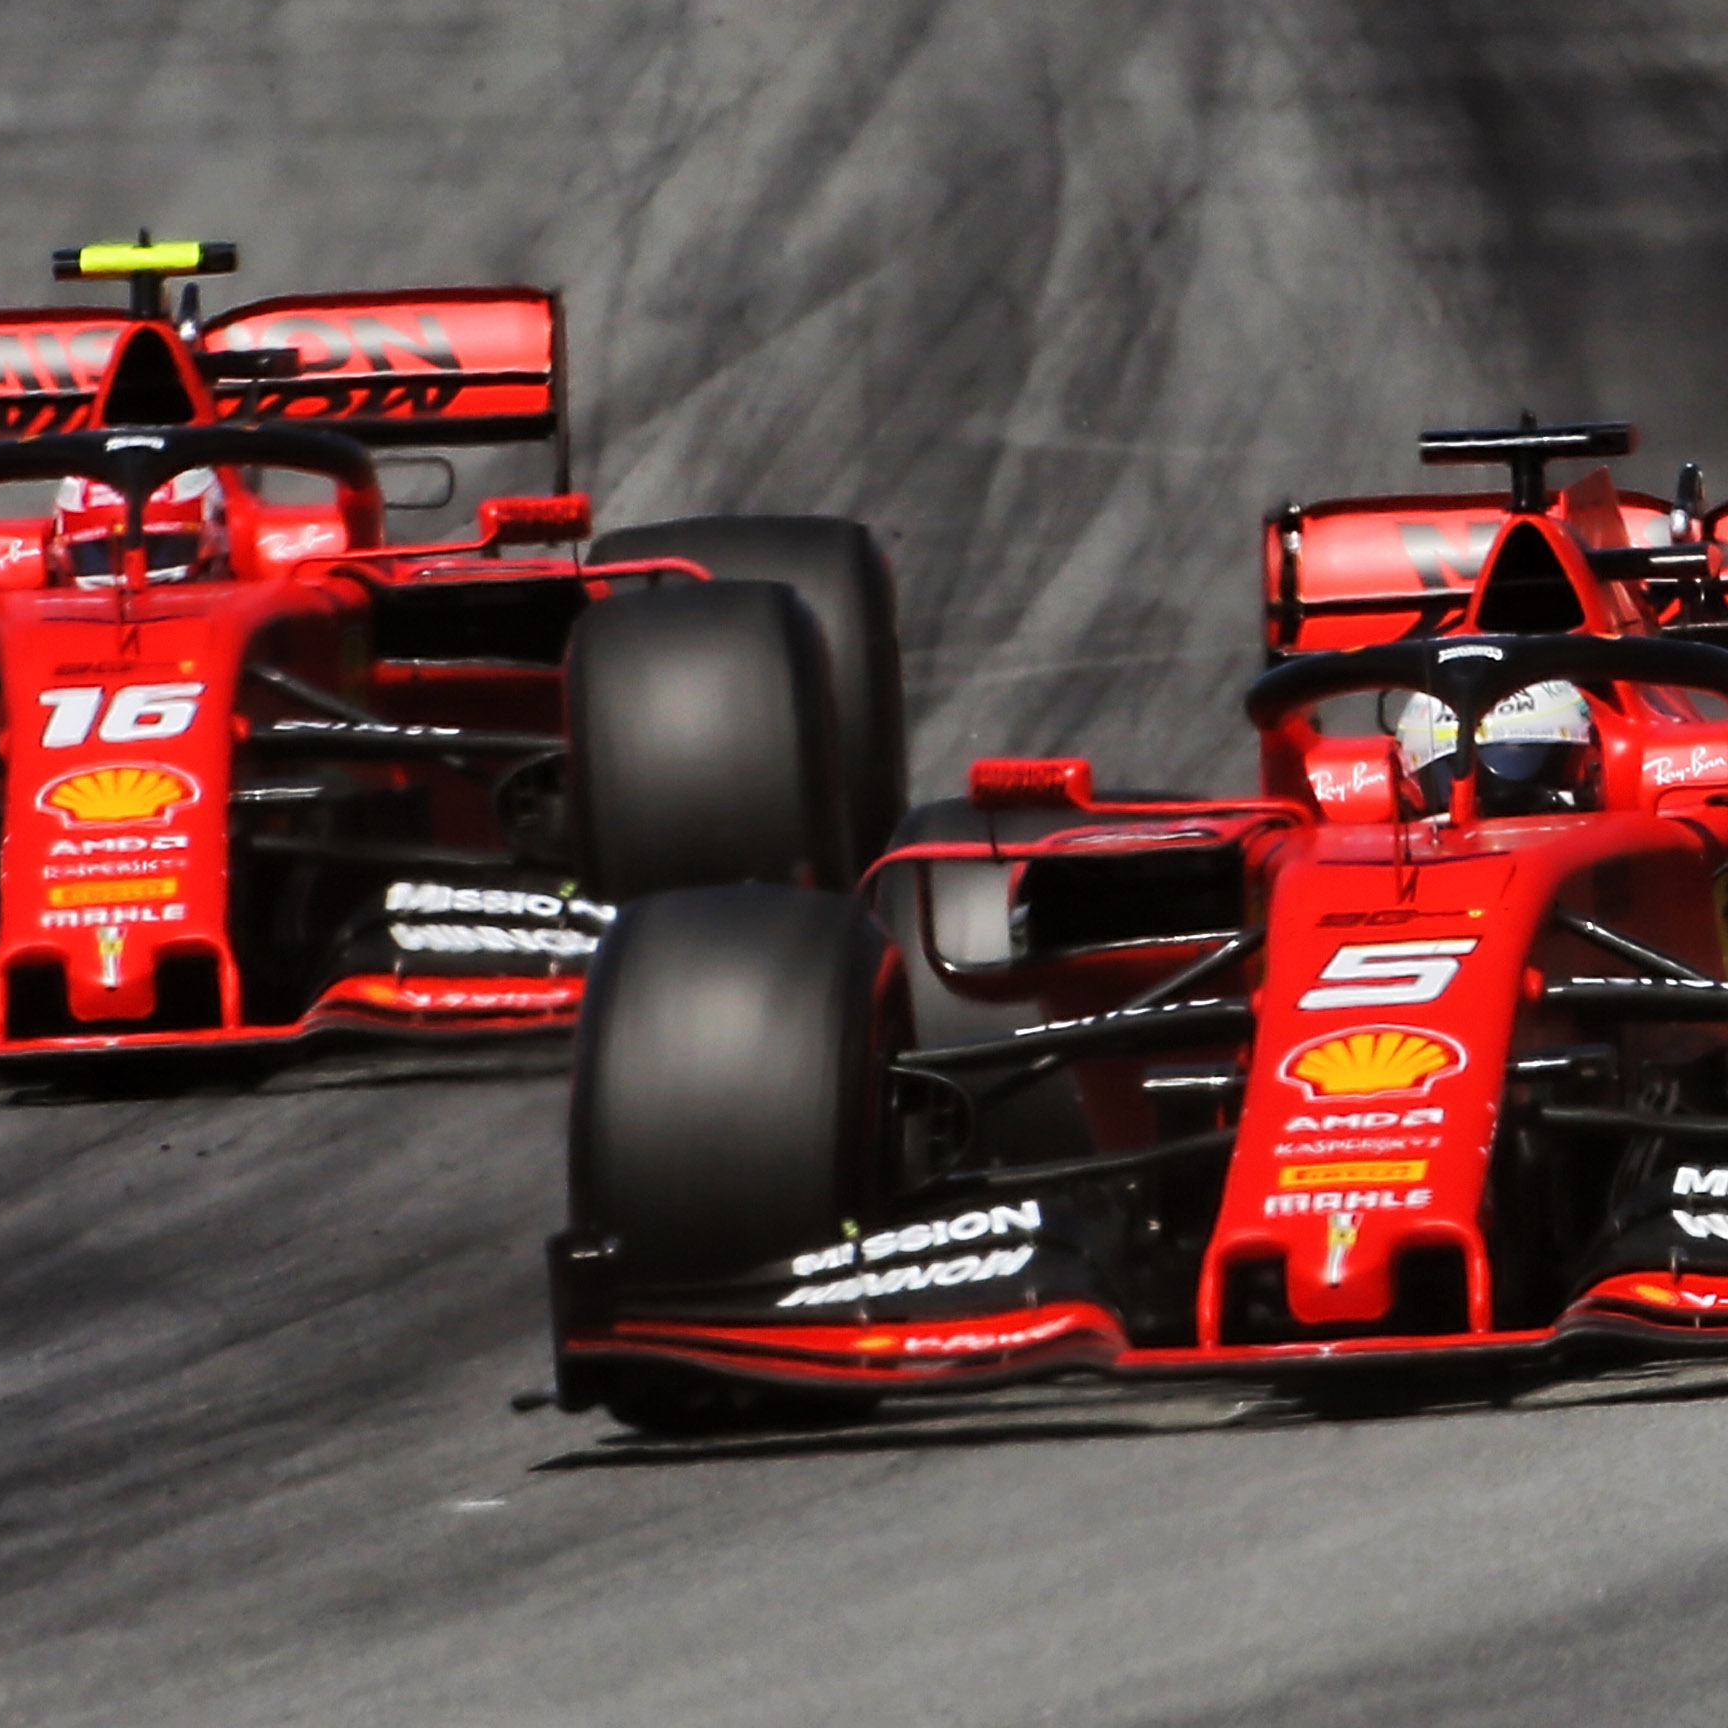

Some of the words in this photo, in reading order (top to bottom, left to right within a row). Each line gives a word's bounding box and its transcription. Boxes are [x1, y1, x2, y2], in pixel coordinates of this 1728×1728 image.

[38, 682, 207, 749] 16
[49, 837, 148, 856] AMD
[40, 904, 186, 930] MAHLE
[385, 882, 618, 922] MISSION
[1296, 937, 1479, 1012] 5
[1284, 1112, 1400, 1132] AMD
[1263, 1189, 1434, 1217] MAHLE
[791, 1200, 1042, 1276] MISSION
